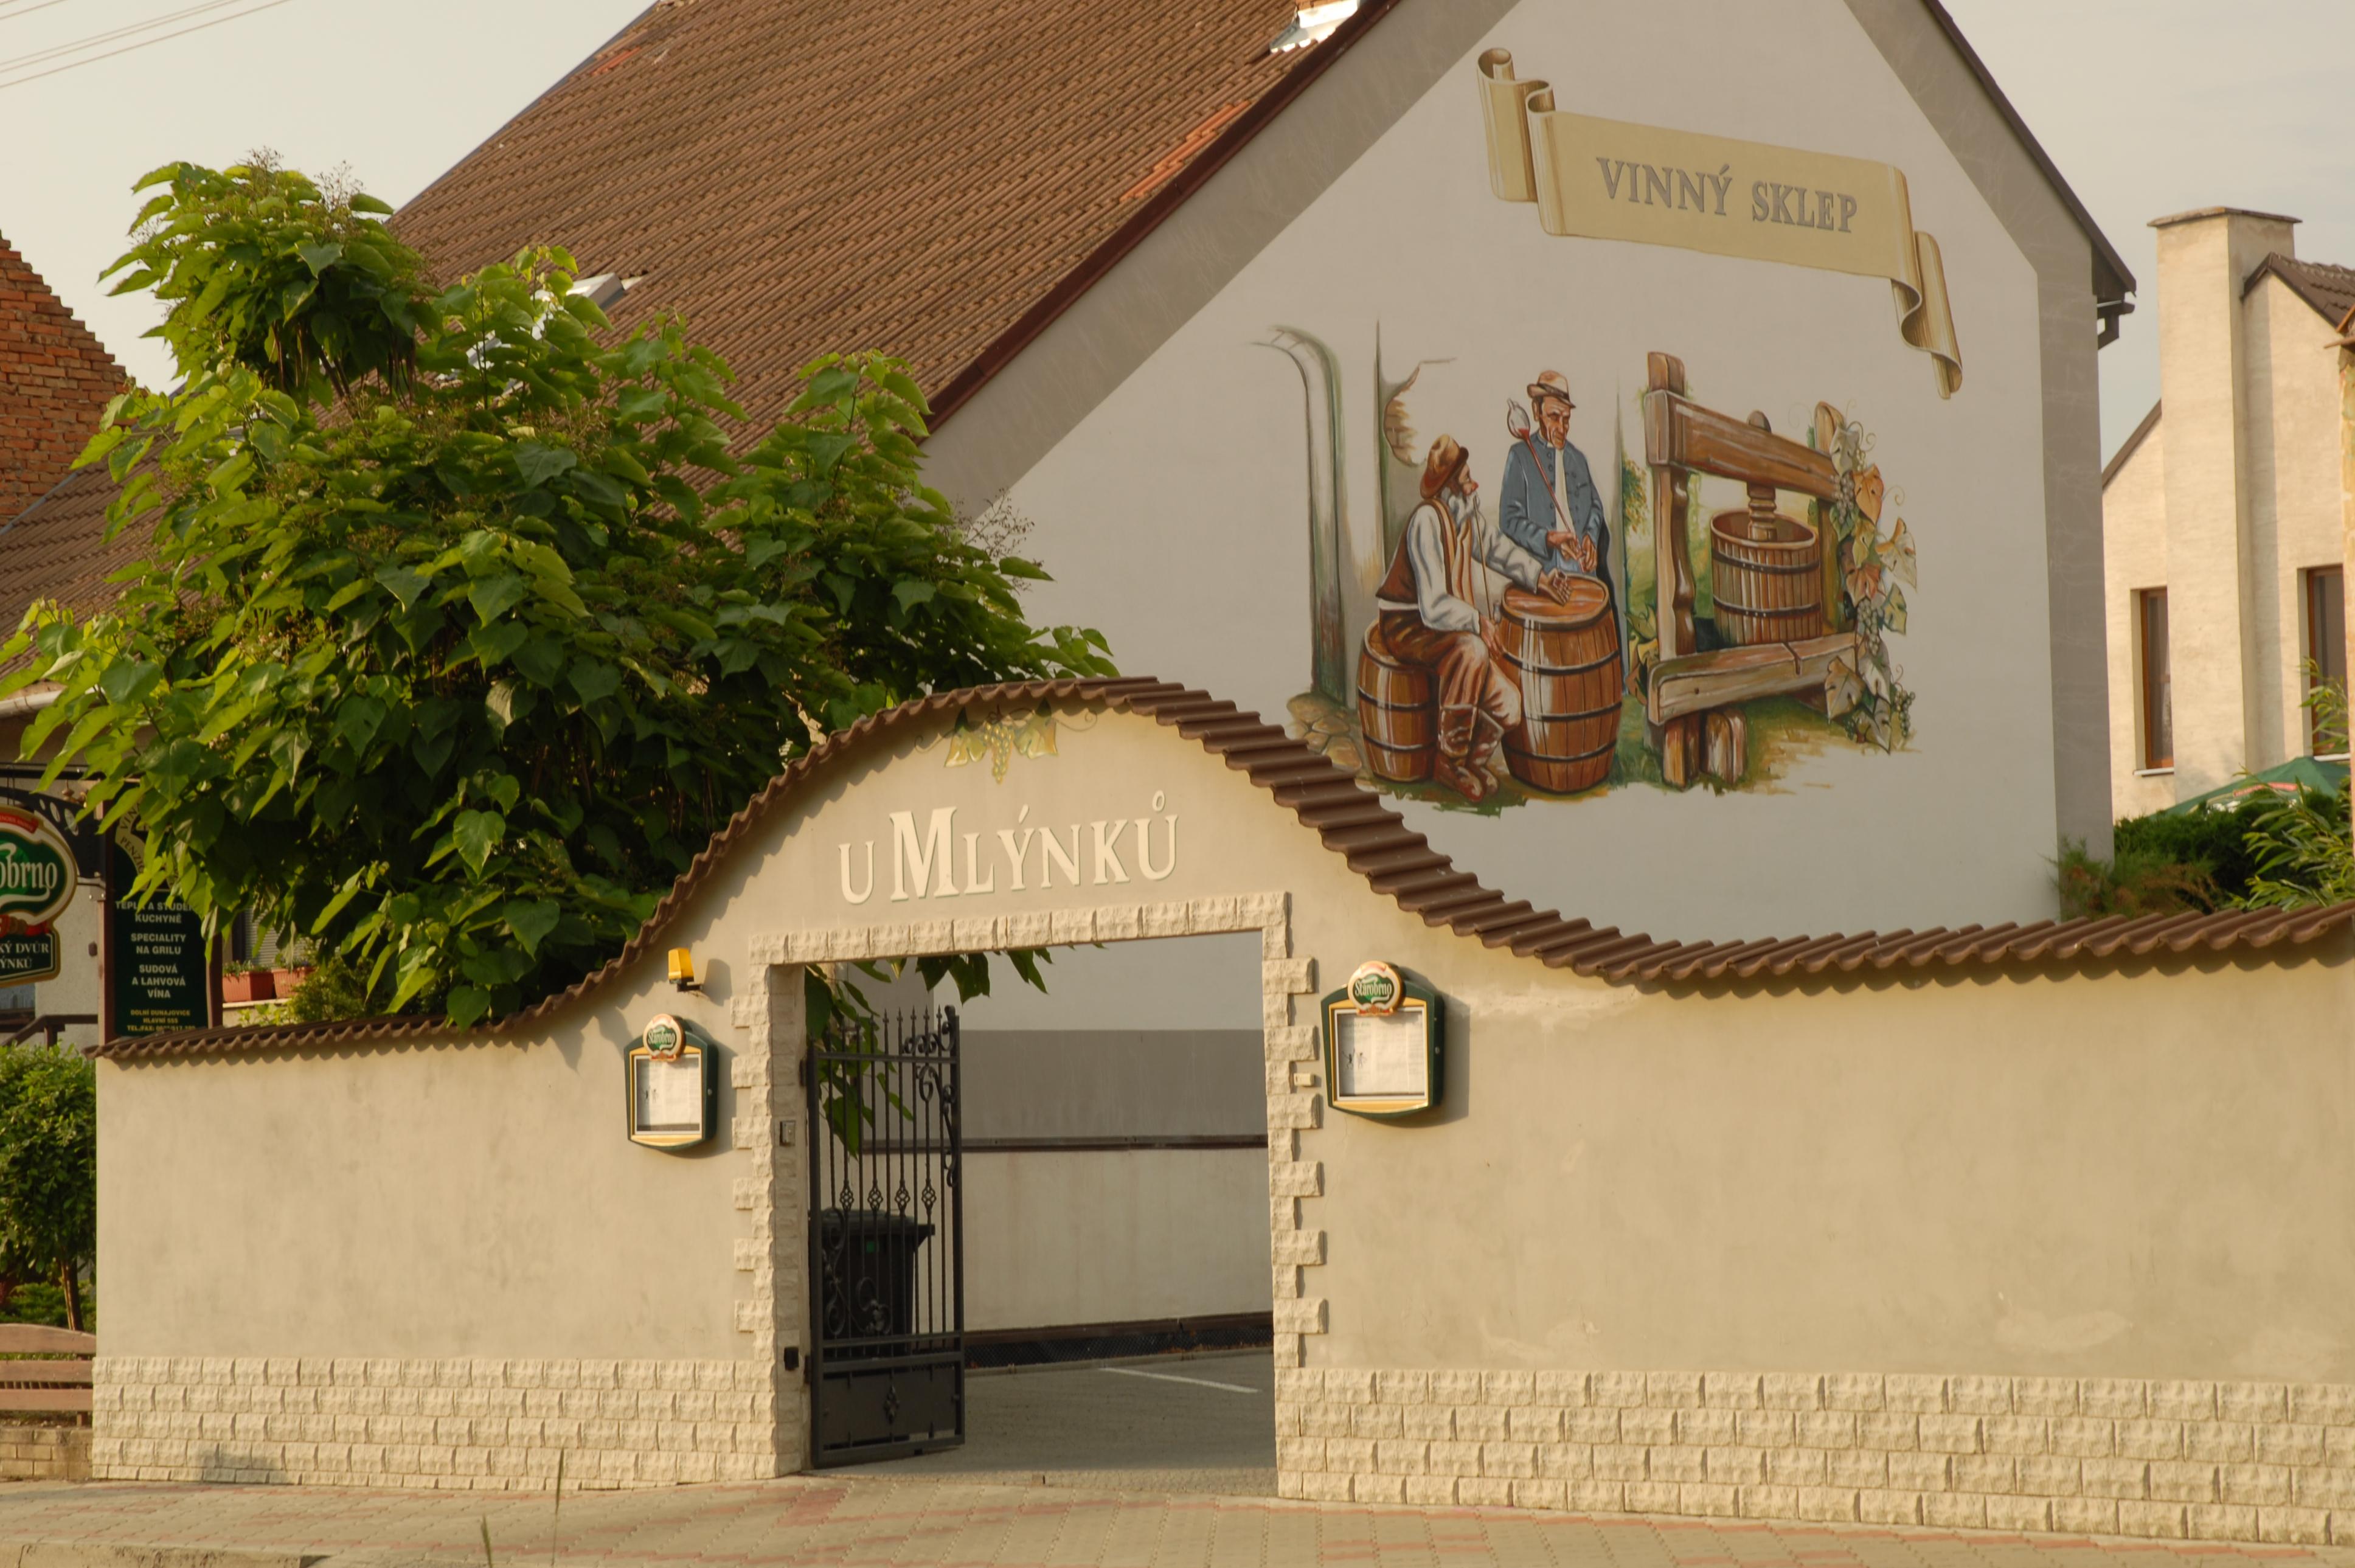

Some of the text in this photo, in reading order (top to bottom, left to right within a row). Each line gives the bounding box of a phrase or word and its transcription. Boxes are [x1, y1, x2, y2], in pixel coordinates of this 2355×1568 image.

[1595, 156, 1858, 233] VINNÝ SKLEP
[838, 790, 1179, 904] U MLÝNKŮ
[115, 900, 145, 911] TEPL
[148, 901, 154, 911] A
[131, 933, 186, 943] SPECIALITY
[16, 940, 49, 954] DVŮR
[136, 945, 181, 955] NA GRILU
[139, 963, 178, 974] SUDOVÁ
[131, 976, 186, 986] A LAHVOVÁ
[147, 988, 171, 998] VÍNA
[1354, 977, 1392, 1001] Starobrno
